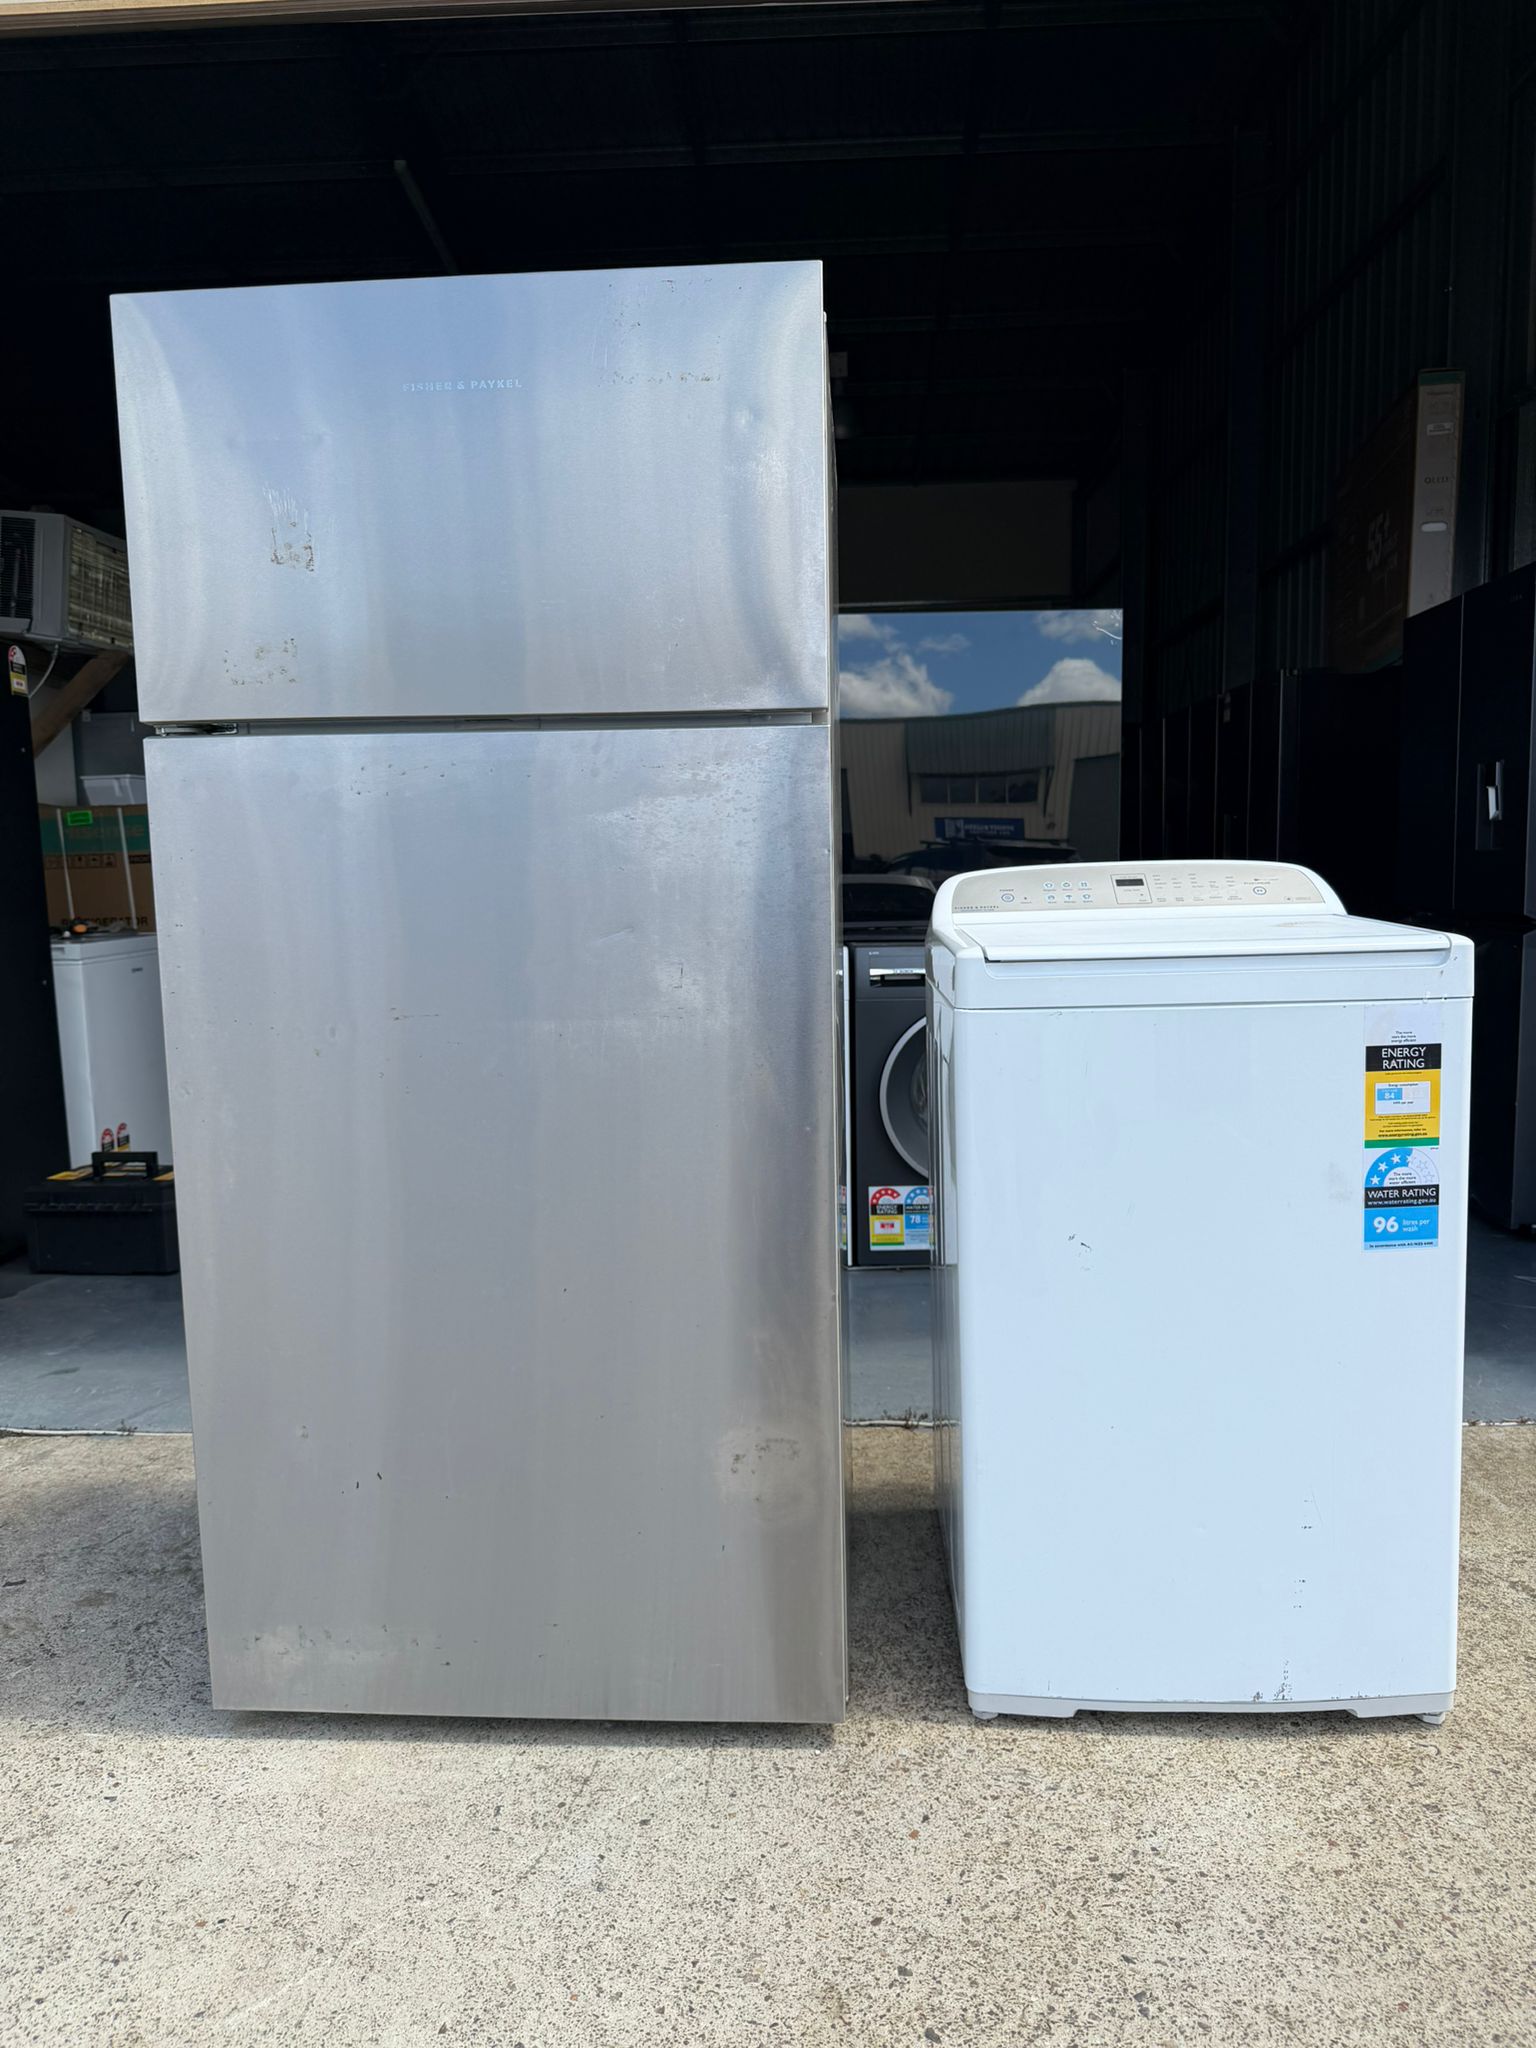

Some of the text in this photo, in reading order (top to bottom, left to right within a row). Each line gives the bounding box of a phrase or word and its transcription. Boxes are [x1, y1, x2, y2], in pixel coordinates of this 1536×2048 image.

[401, 378, 523, 392] FISHER & PAYKEL
[1381, 1047, 1426, 1058] ENERGY
[1382, 1058, 1425, 1069] RATING
[1367, 1188, 1436, 1198] WATER RATING
[910, 1215, 920, 1224] 78
[1373, 1216, 1399, 1233] 96
